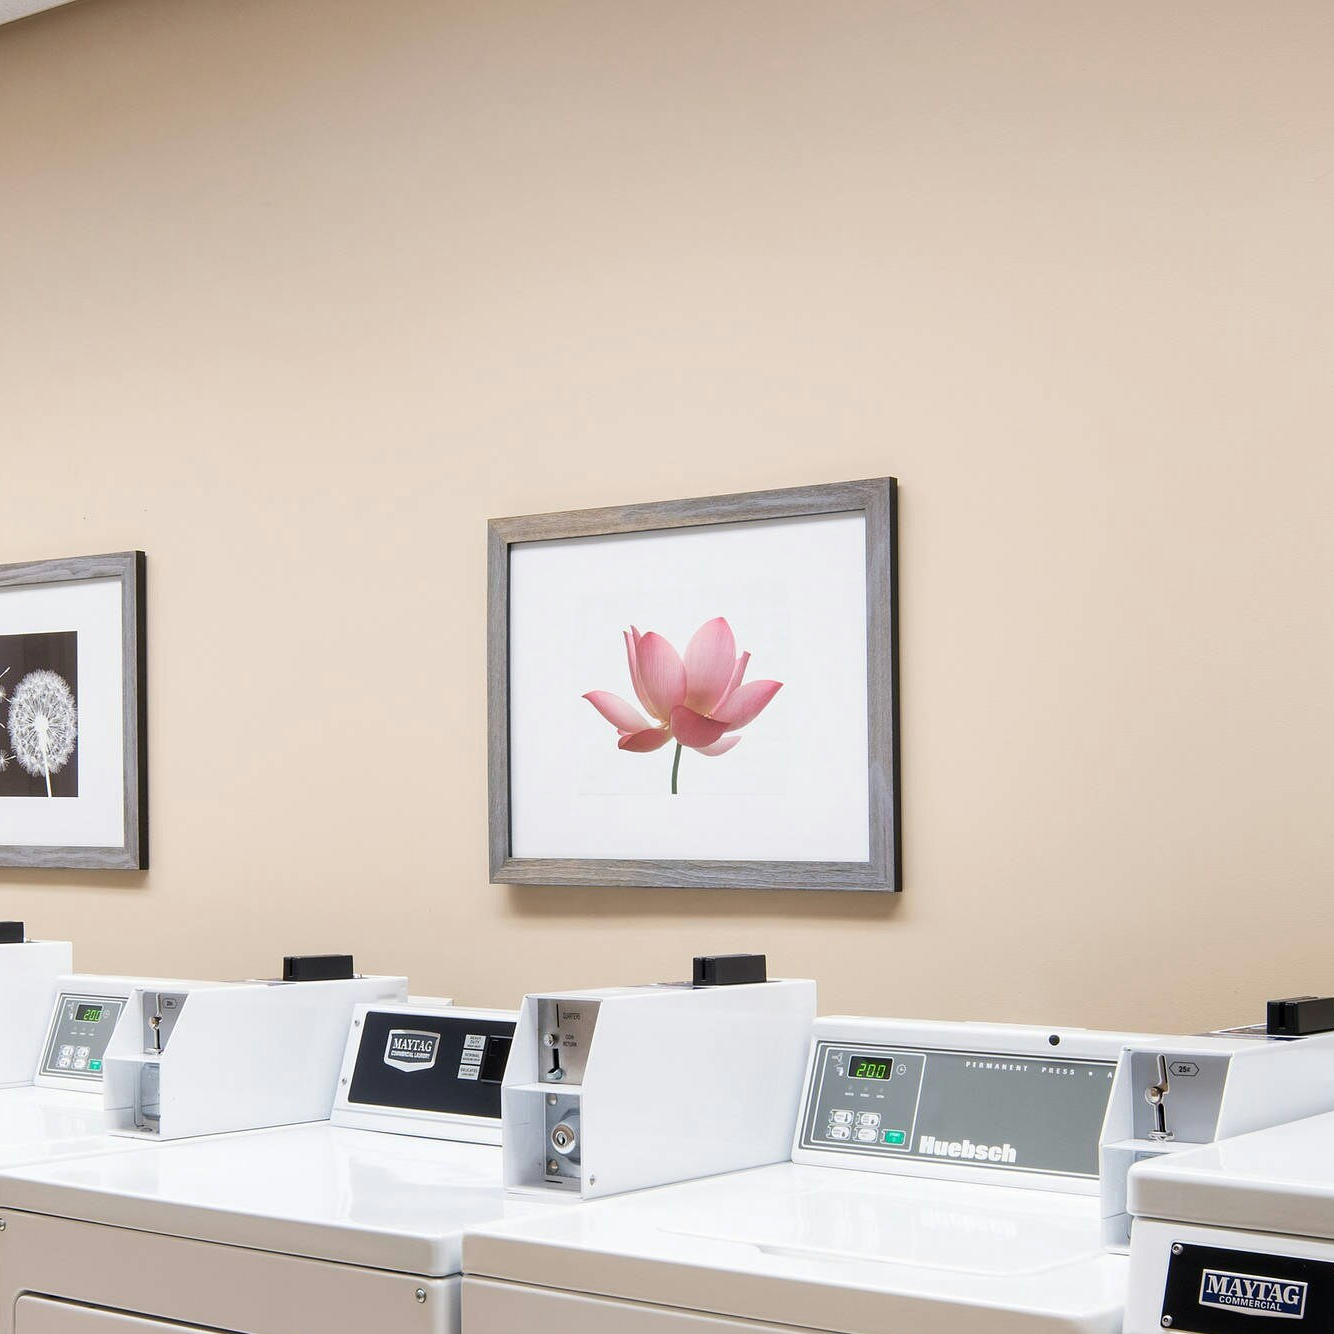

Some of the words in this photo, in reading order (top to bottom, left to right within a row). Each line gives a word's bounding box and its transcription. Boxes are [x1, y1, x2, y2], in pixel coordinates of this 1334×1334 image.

[392, 1037, 433, 1052] MAYTAG
[965, 1061, 1029, 1072] PERMANENT
[1041, 1066, 1076, 1076] PRESS
[918, 1135, 1017, 1163] Huebsch
[1205, 1274, 1300, 1306] MAYTAG
[1219, 1295, 1282, 1311] COMMERCIAL
